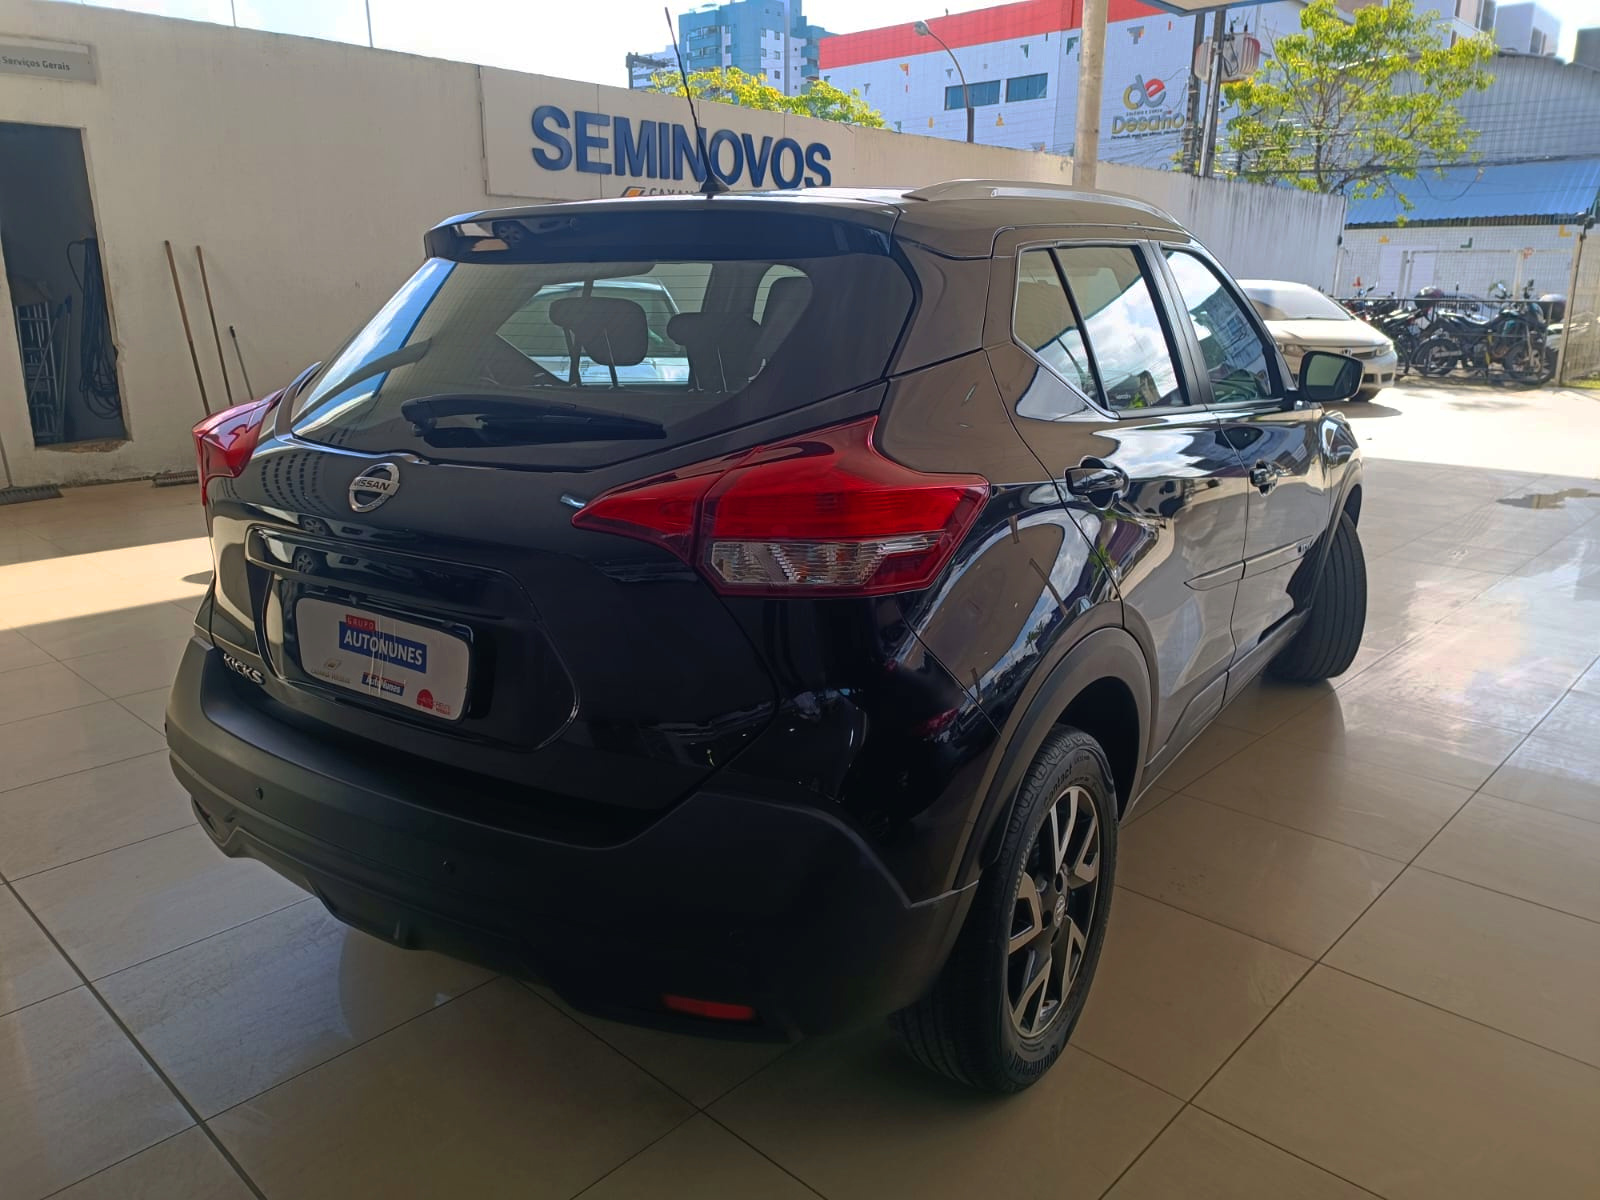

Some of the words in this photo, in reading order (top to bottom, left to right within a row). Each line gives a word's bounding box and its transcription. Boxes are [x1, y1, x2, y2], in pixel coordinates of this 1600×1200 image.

[1, 56, 41, 68] Serviços
[42, 60, 71, 71] Gerais
[531, 104, 832, 189] SEMINOVOS
[347, 616, 374, 629] GRUPO
[343, 629, 423, 666] AUTONUNES
[223, 653, 263, 684] KICKS
